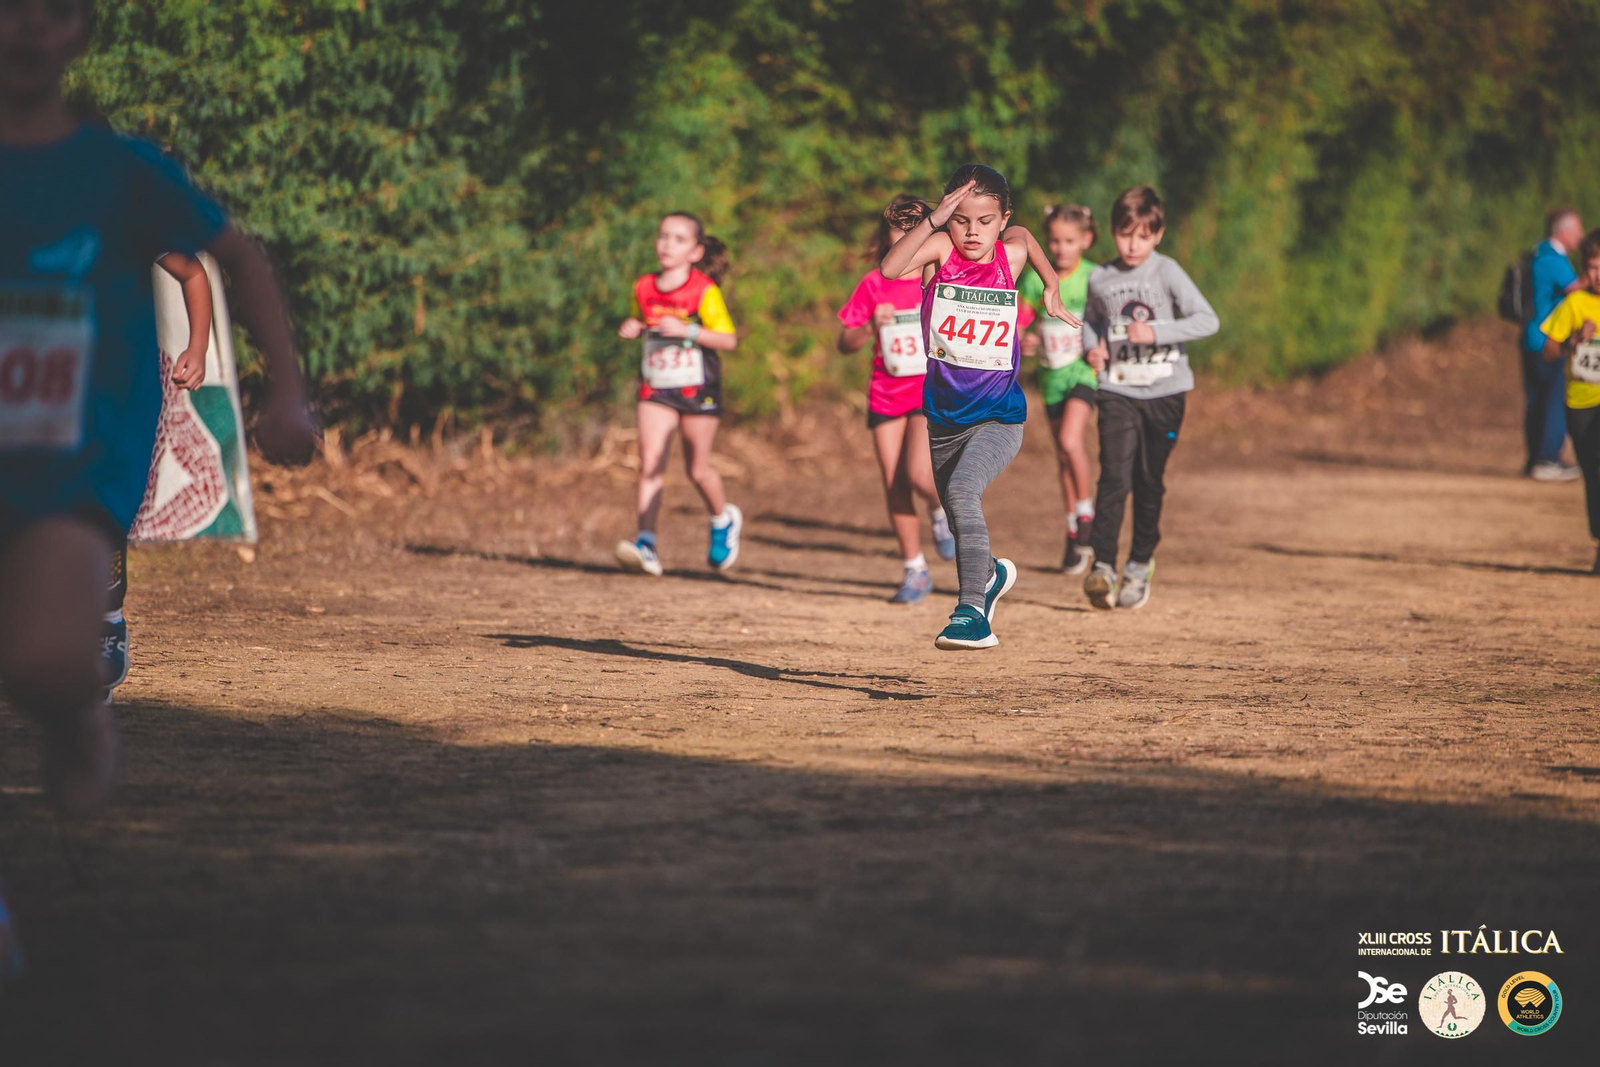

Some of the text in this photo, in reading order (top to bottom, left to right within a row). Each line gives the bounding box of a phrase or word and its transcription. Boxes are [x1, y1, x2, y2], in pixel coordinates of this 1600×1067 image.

[961, 290, 999, 303] ITÁLICA
[938, 315, 1009, 347] 4472
[890, 335, 918, 356] 43
